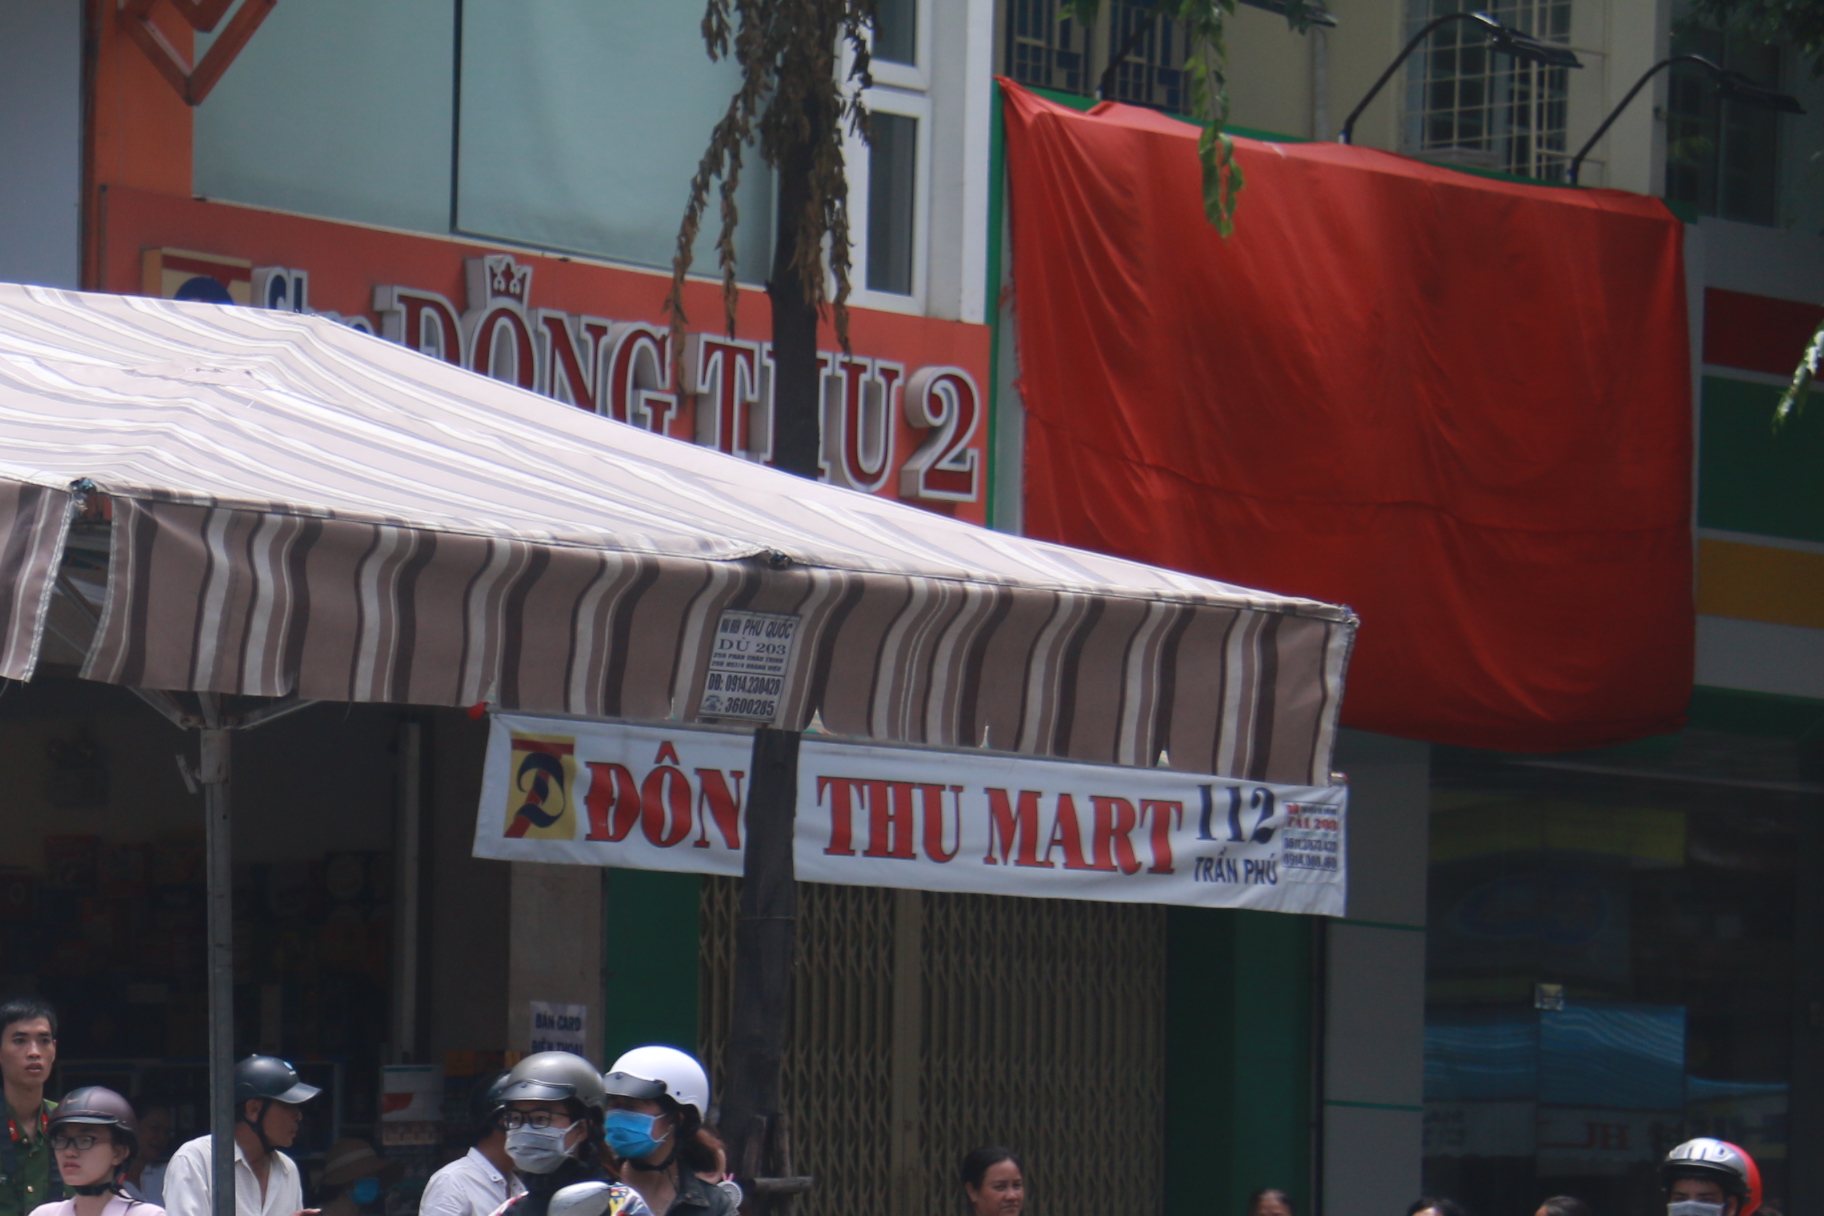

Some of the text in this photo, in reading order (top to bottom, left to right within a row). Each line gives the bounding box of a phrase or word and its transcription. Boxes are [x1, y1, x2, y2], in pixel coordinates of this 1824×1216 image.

[908, 365, 980, 502] 2
[717, 636, 787, 656] DÙ 203
[724, 697, 775, 717] 3600285
[584, 740, 747, 850] ĐÔN
[816, 776, 964, 864] THU
[983, 787, 1184, 876] MART
[1196, 784, 1276, 845] 112
[1194, 847, 1239, 884] TRẦN
[1243, 853, 1278, 886] PHÚ
[535, 1009, 581, 1032] BÁN CARD
